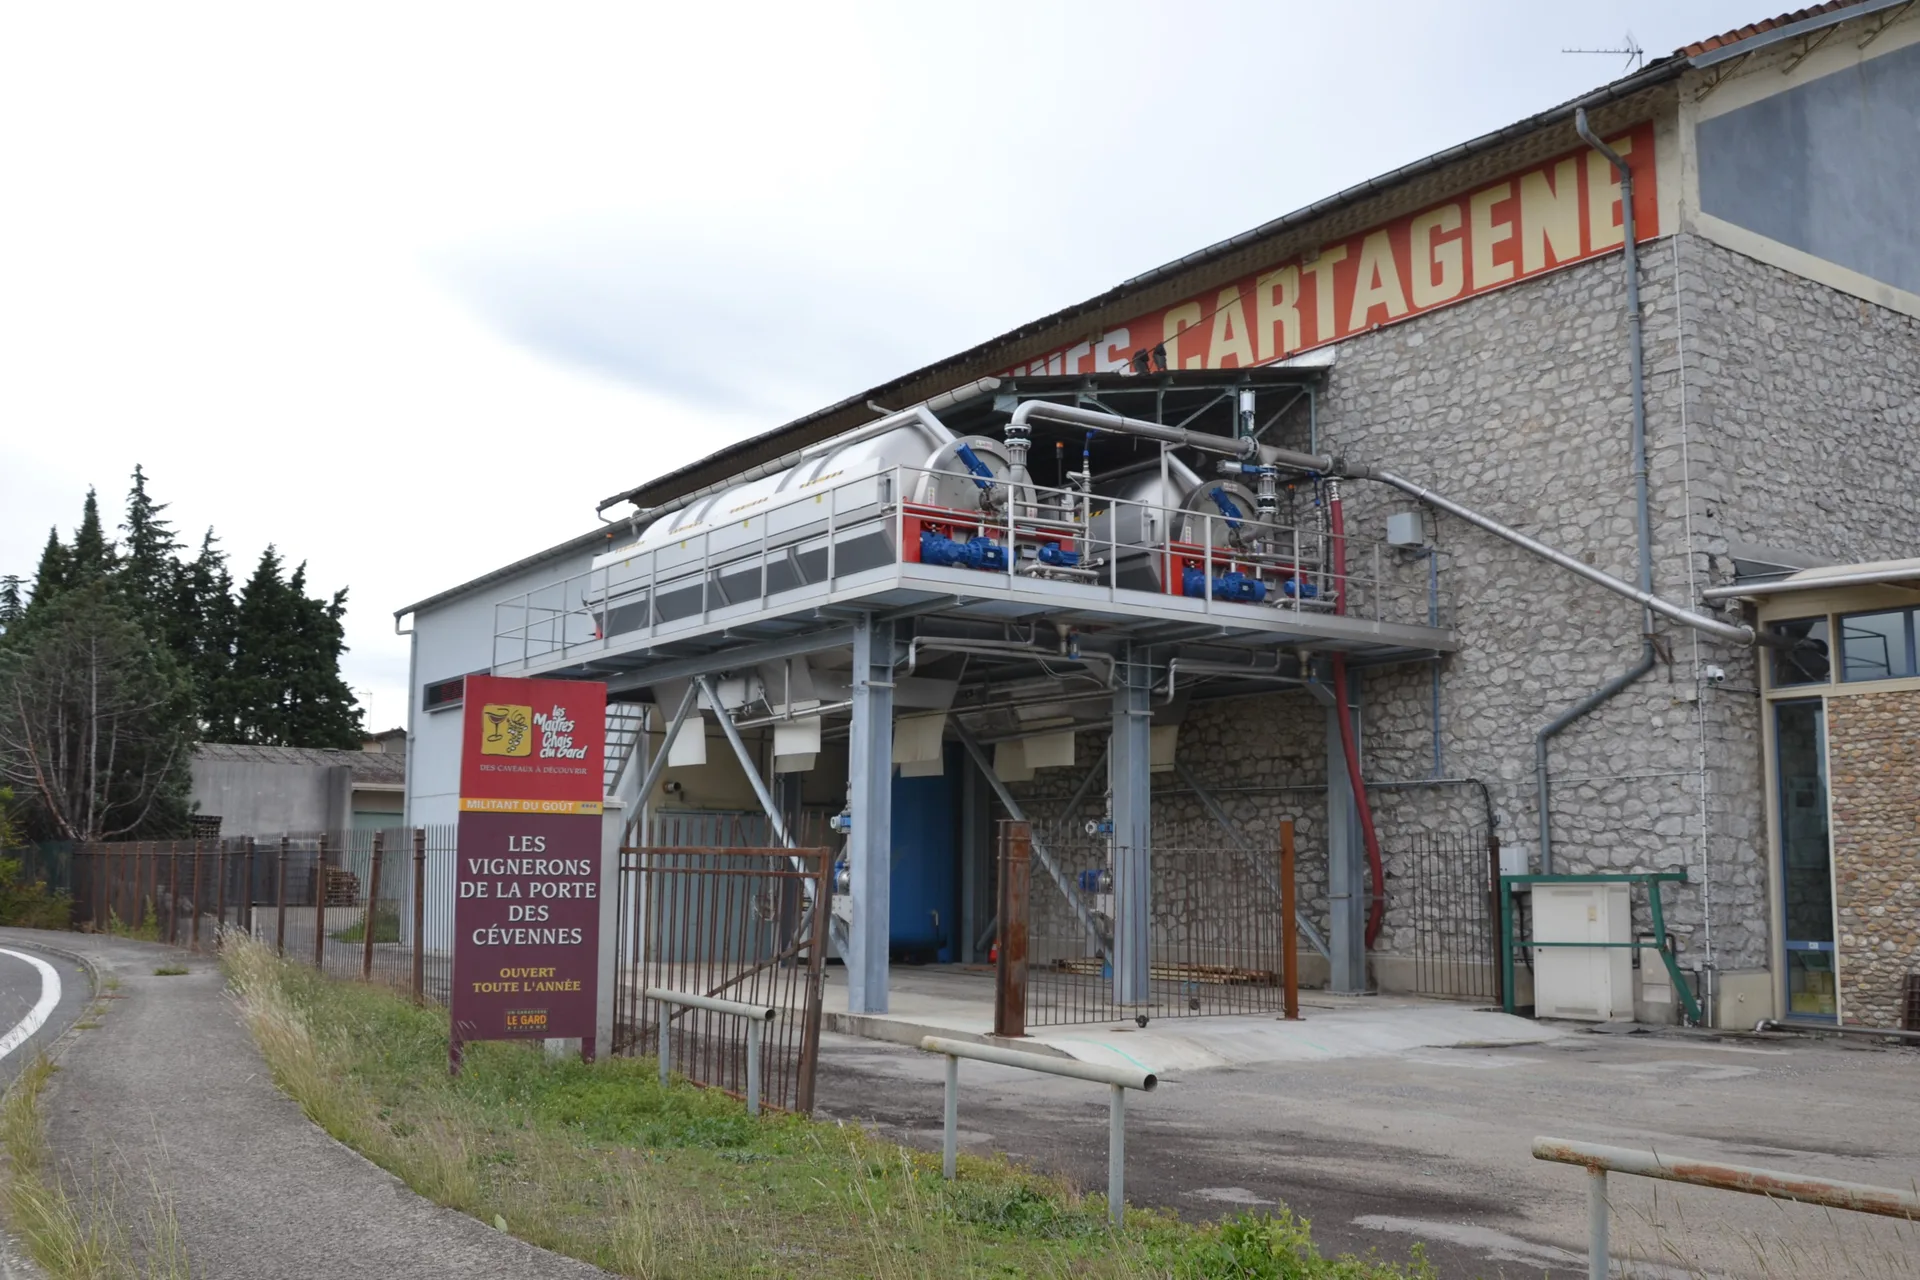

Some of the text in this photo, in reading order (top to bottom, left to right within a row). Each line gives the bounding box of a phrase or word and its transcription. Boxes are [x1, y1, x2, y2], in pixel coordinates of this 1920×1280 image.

[1163, 135, 1634, 370] CARTAGENE
[542, 730, 573, 748] Chais
[540, 745, 588, 759] du Gard
[480, 764, 496, 772] DES
[497, 764, 533, 773] CAVEAUX
[543, 766, 588, 775] DÉCOUVRIR
[466, 799, 519, 810] MILITANT
[522, 801, 538, 811] DU
[508, 835, 546, 852] LES
[468, 858, 591, 876] VIGNERONS
[459, 881, 597, 899] DE LA PORTE
[508, 905, 549, 922] DES
[472, 923, 582, 945] CÉVENNES
[500, 967, 556, 978] OUVERT
[472, 979, 581, 993] TOUTE L'ANNÉE
[507, 1014, 547, 1025] LE GARD
